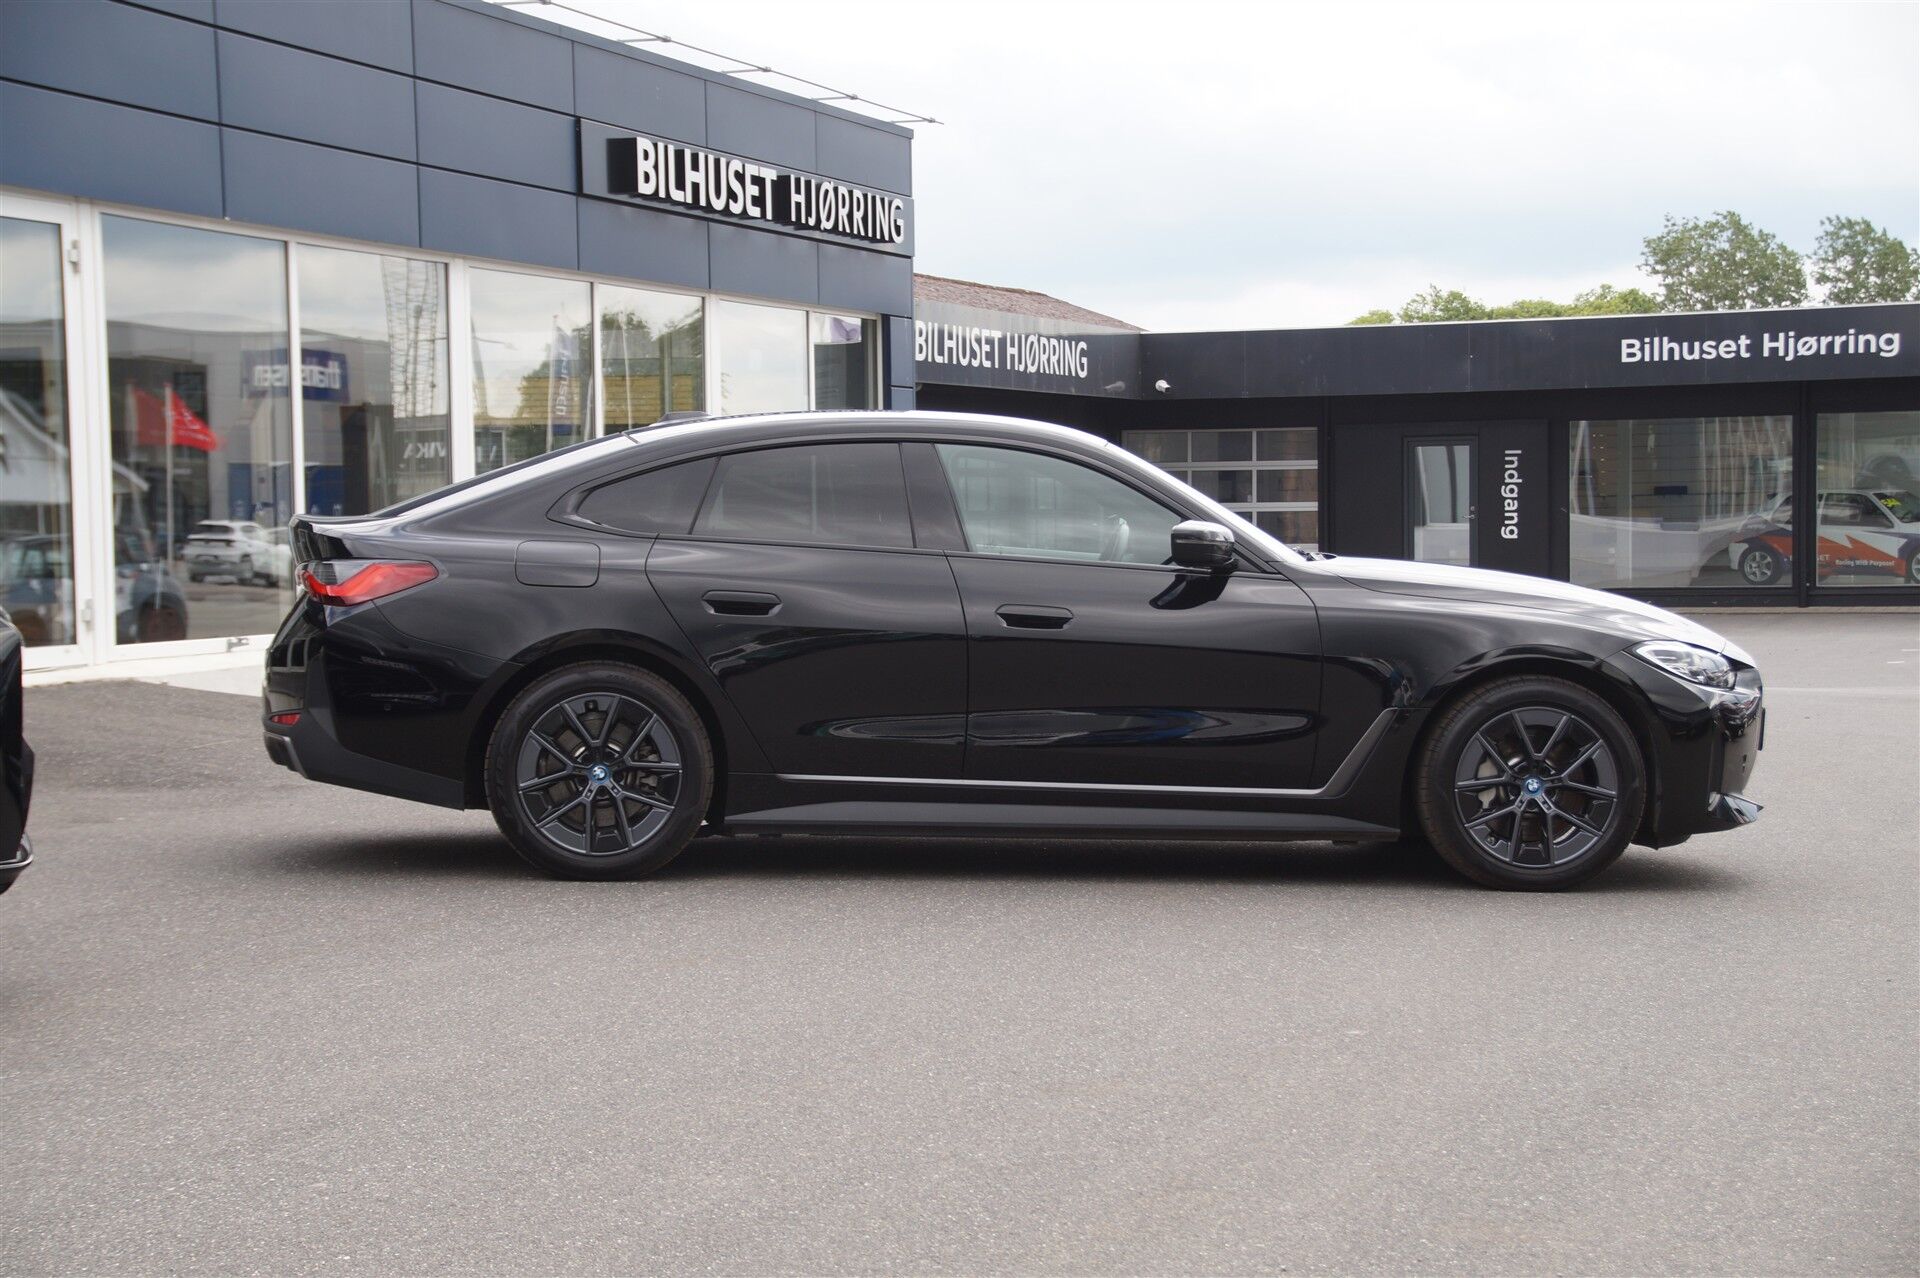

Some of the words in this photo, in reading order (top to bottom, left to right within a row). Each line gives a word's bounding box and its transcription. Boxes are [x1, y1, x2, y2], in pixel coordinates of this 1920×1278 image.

[636, 137, 777, 221] BILHUSET
[790, 174, 905, 244] HJØRRING
[915, 320, 1002, 368] BILHUSET
[1006, 333, 1088, 378] HJØRRING
[1621, 334, 1751, 363] Bilhuset
[1762, 328, 1900, 362] Hjørring
[1501, 451, 1522, 539] Indgang
